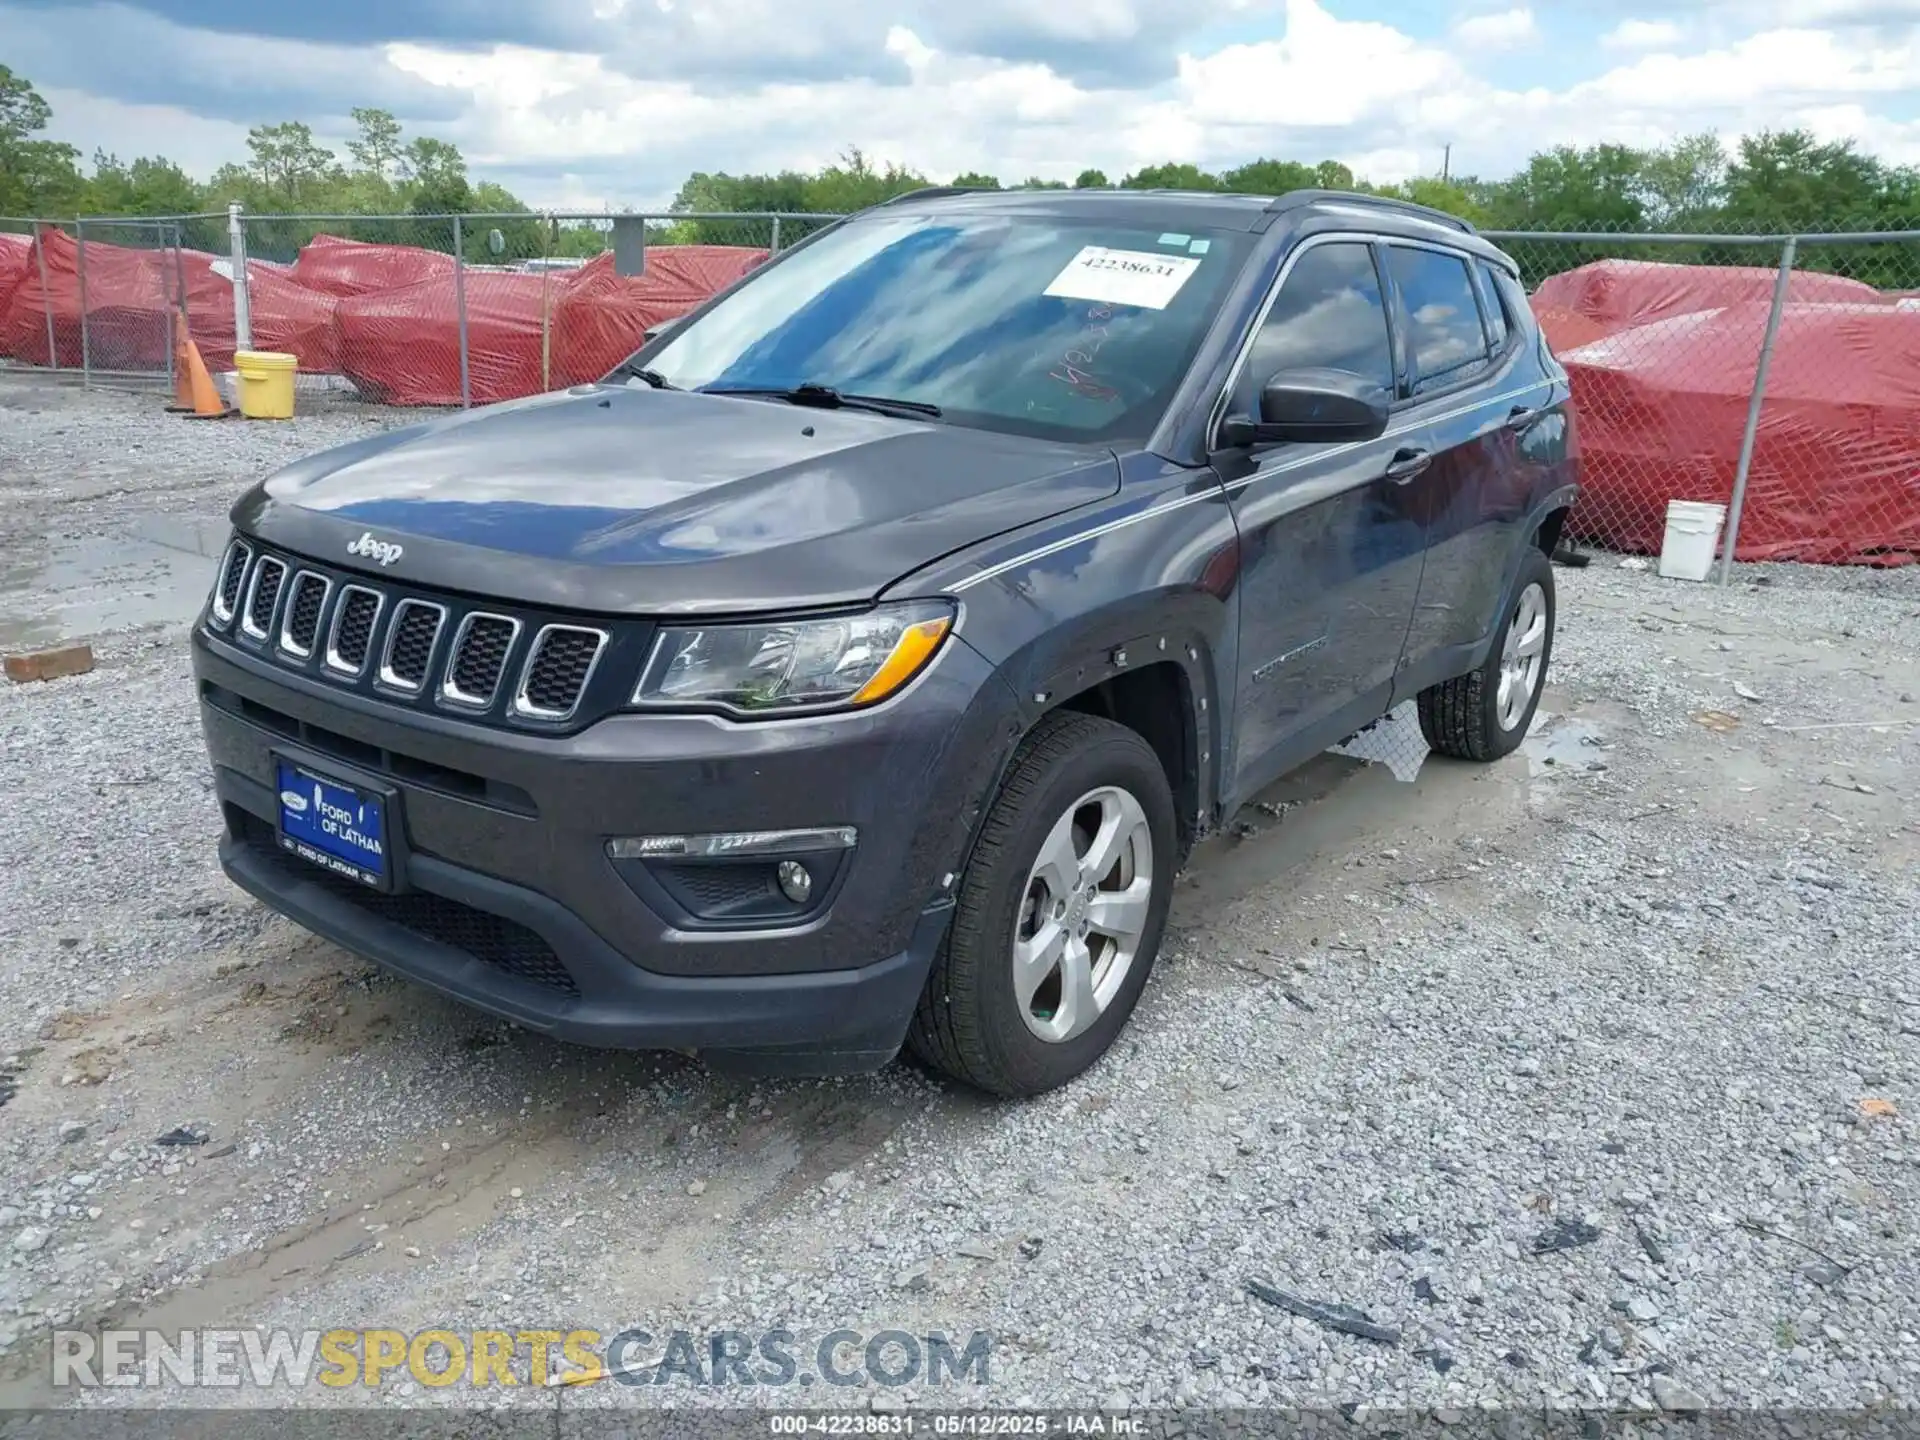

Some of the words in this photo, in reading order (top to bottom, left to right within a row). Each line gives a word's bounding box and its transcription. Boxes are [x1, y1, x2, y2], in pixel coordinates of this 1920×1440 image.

[1081, 257, 1175, 277] 42238631
[346, 531, 403, 567] Jeep
[320, 801, 353, 825] FORD
[321, 818, 339, 836] OF
[297, 844, 317, 860] FORD
[316, 854, 328, 865] OF
